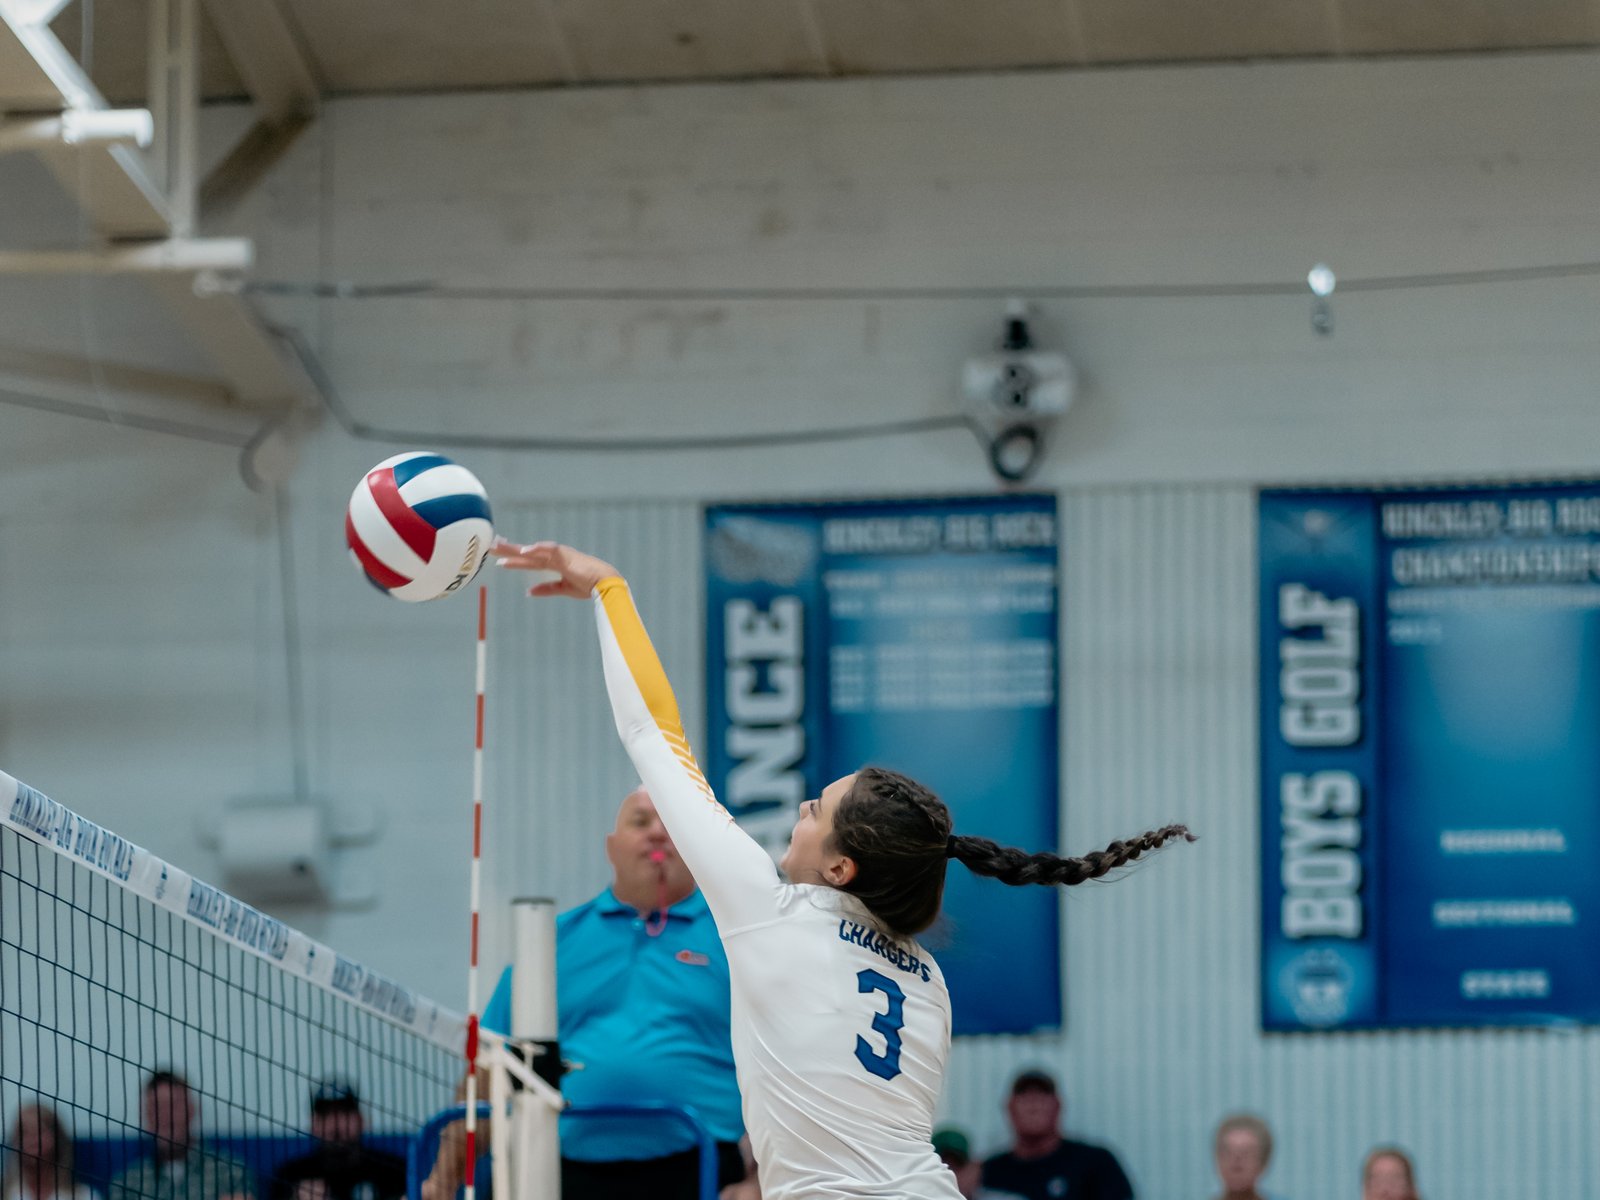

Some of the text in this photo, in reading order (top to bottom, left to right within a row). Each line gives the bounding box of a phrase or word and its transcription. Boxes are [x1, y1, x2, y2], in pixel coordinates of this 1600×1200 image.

[1279, 582, 1361, 746] GOLF
[1280, 770, 1362, 939] BOYS
[838, 918, 933, 983] CHARGERS
[854, 968, 907, 1081] 3
